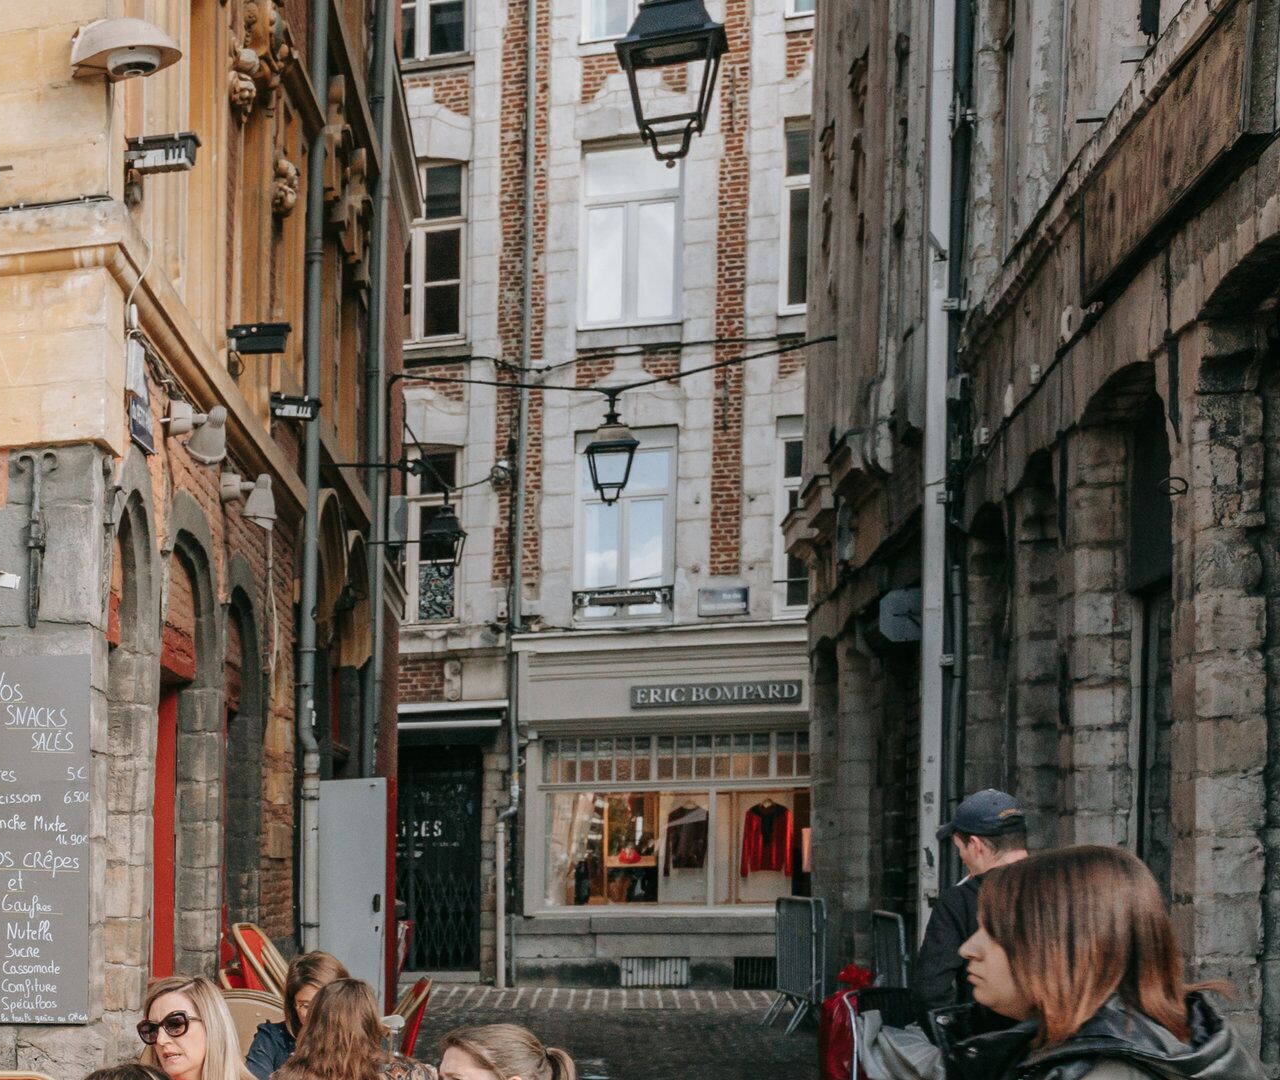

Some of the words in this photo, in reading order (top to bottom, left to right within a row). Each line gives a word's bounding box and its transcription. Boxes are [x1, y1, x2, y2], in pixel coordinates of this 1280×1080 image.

[636, 687, 686, 704] ERIC
[692, 683, 799, 701] BOMPARD
[4, 704, 68, 728] SNACKS
[31, 730, 74, 751] SALÉS
[33, 814, 68, 832] Mixte
[23, 850, 80, 878] crêpes
[7, 870, 23, 891] et
[1, 894, 53, 918] Gaufres
[6, 920, 53, 942] Nutella
[5, 942, 40, 958] Sucre
[2, 960, 61, 974] Cassonade
[1, 978, 58, 998] Confiture
[1, 995, 58, 1013] Spéculoos
